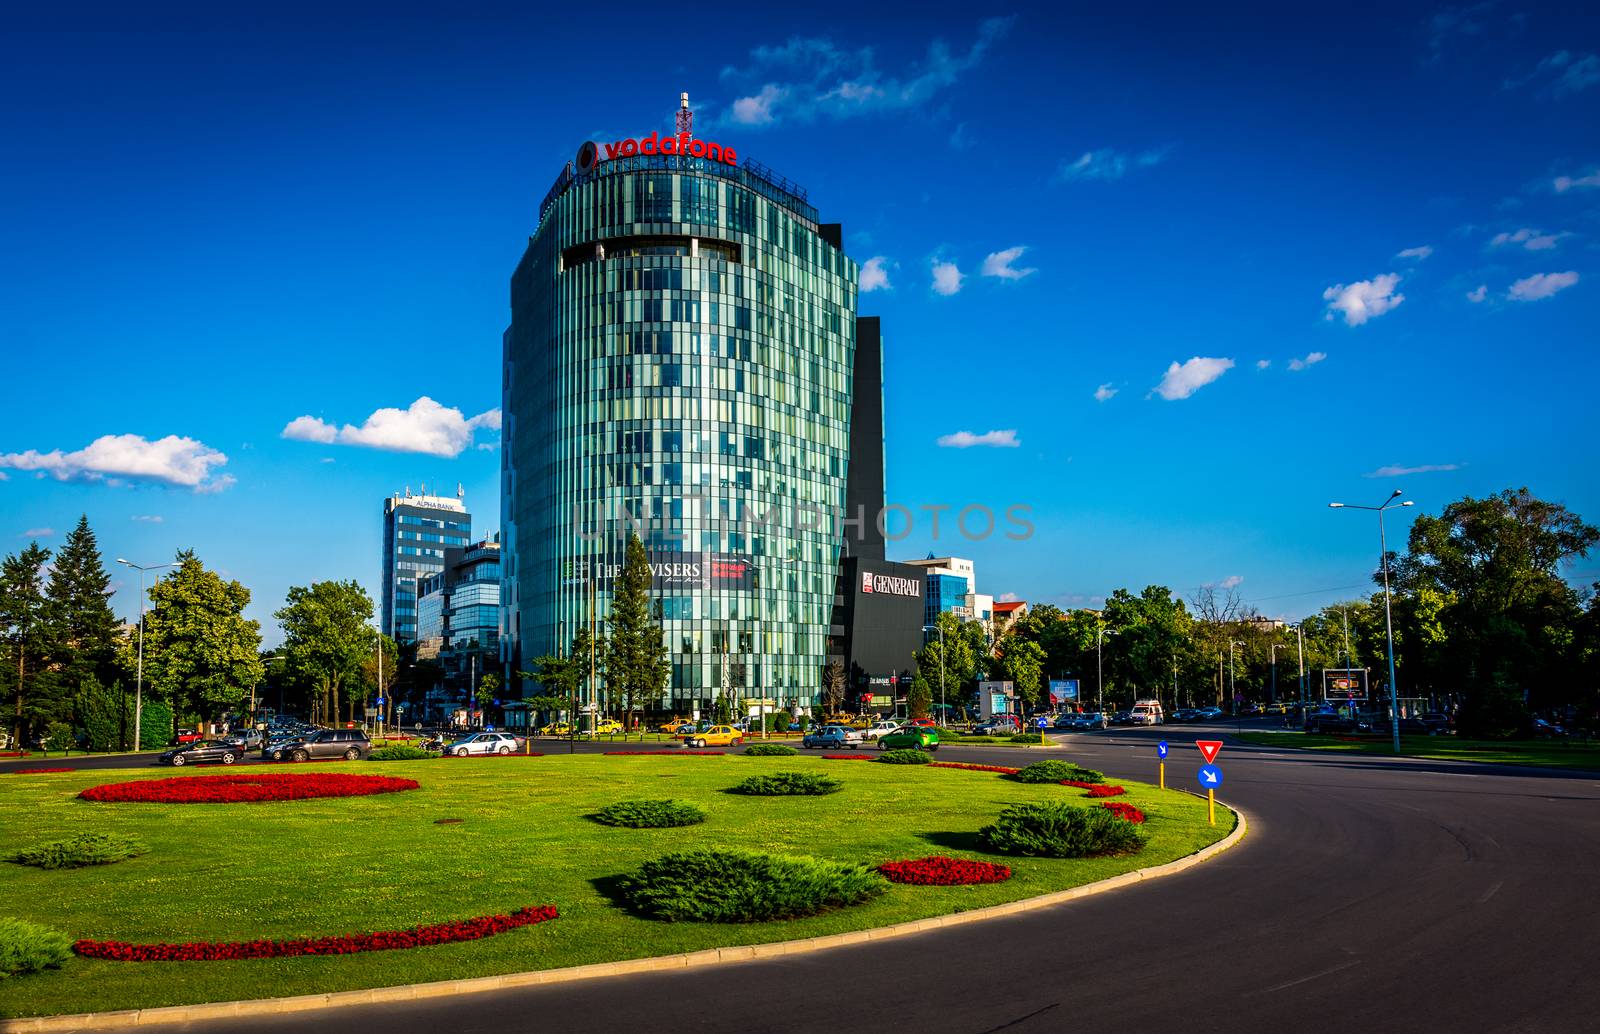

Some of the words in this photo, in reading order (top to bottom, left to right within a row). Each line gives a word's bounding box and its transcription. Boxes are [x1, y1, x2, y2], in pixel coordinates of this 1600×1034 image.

[605, 131, 737, 166] vodafone
[416, 500, 437, 509] ALPHA
[438, 503, 455, 511] BANK
[873, 574, 920, 597] GENERALI
